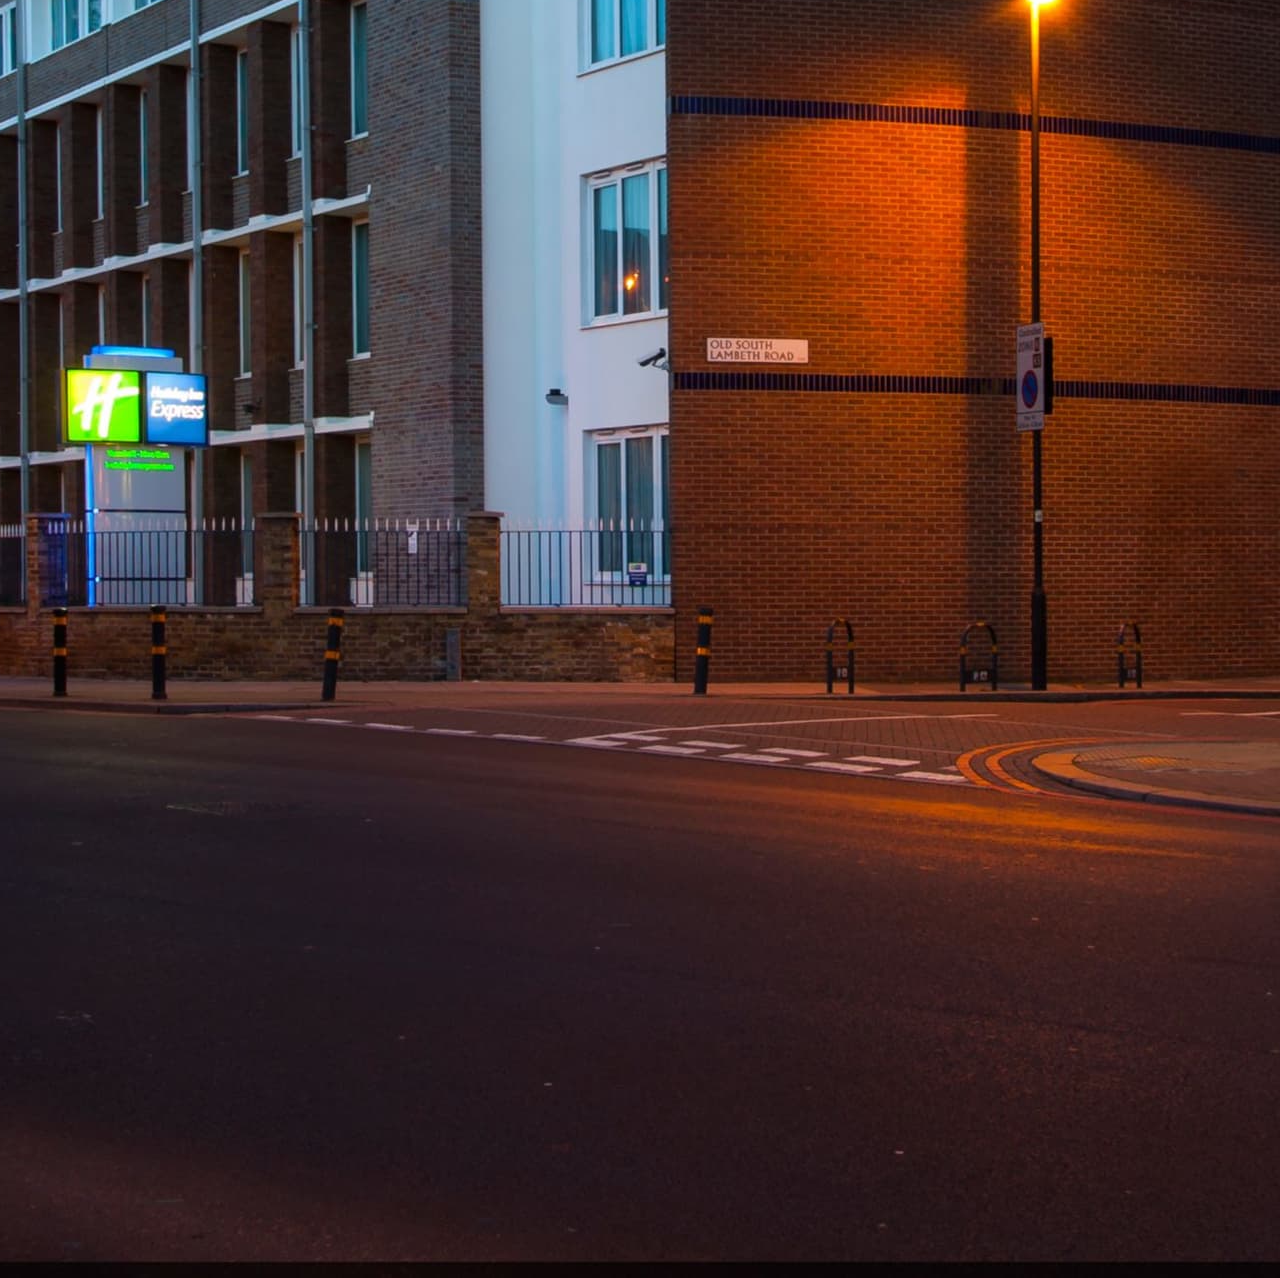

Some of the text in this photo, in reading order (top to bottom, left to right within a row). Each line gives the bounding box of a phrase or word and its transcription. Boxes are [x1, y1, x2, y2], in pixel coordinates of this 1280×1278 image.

[710, 339, 773, 350] OLD SOUTH
[710, 350, 761, 360] LAMBETH
[764, 351, 794, 361] ROAD
[150, 400, 205, 422] Express
